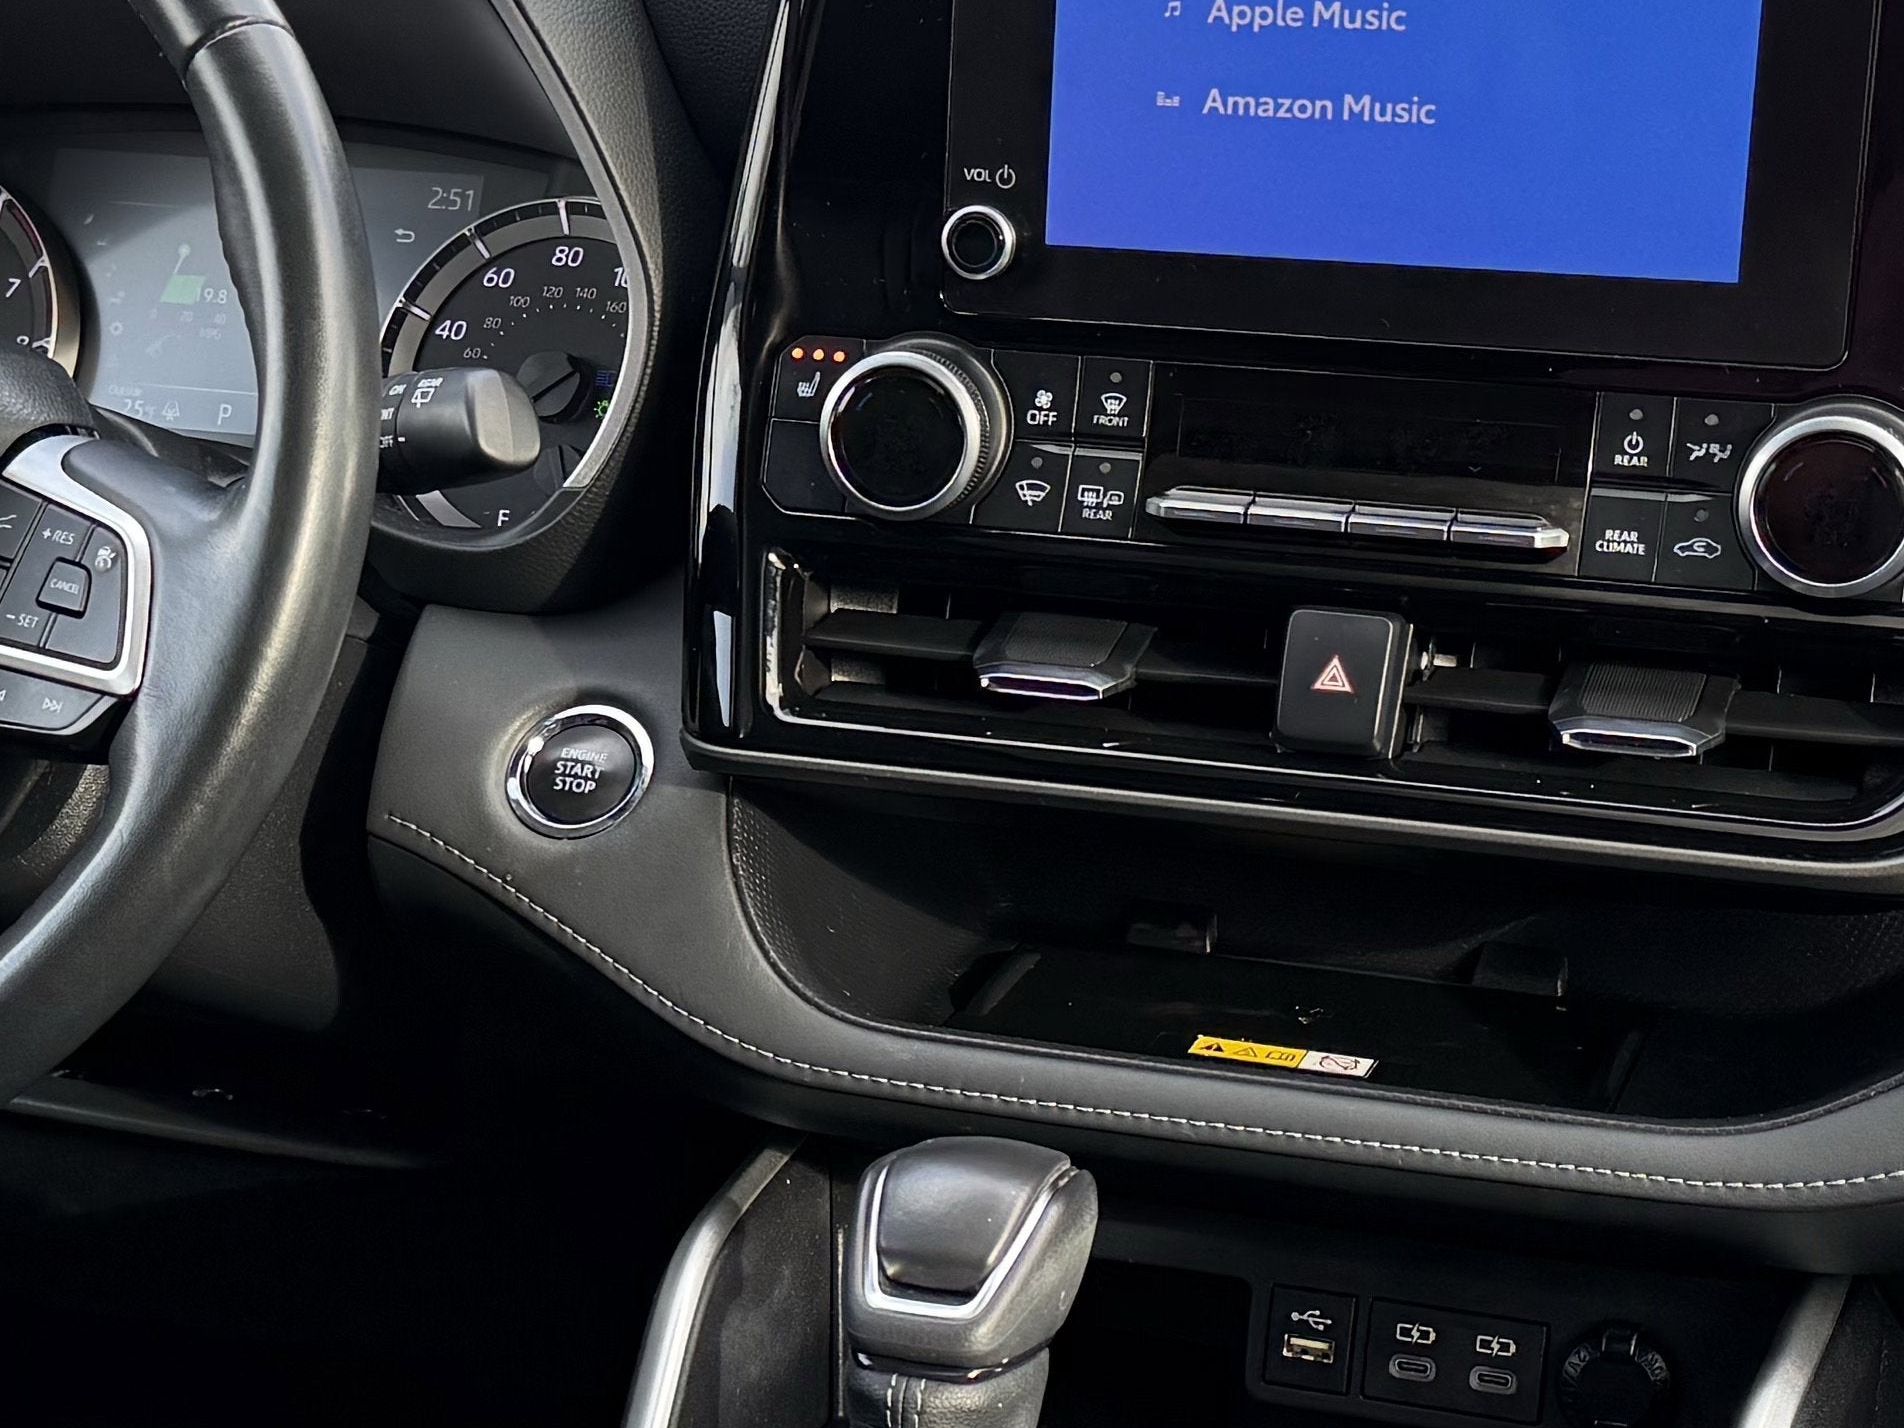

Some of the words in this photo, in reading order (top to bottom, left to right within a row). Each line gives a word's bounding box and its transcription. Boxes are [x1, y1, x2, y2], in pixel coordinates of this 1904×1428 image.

[1312, 0, 1407, 33] Music
[1202, 88, 1333, 123] Amazon
[1343, 93, 1437, 126] Music
[963, 166, 991, 182] VOL
[428, 187, 474, 212] 2:51
[551, 246, 584, 267] 80
[483, 268, 515, 288] 60
[6, 278, 21, 298] 7
[543, 287, 563, 299] 120
[576, 288, 597, 300] 140
[509, 296, 530, 308] 100
[606, 301, 627, 313] 160
[435, 320, 467, 340] 40
[484, 317, 501, 329] 80
[463, 348, 481, 359] 60
[217, 404, 233, 426] P
[1026, 409, 1057, 426] OFF
[1093, 414, 1129, 428] FRONT
[1614, 454, 1648, 468] REAR
[498, 510, 510, 527] F
[1082, 508, 1113, 521] REAR
[1605, 529, 1638, 543] REAR
[1595, 540, 1645, 556] CLIMATE
[50, 578, 80, 596] CANCEL
[561, 747, 608, 764] ENGINE
[555, 761, 604, 779] START
[553, 777, 596, 794] STOP
